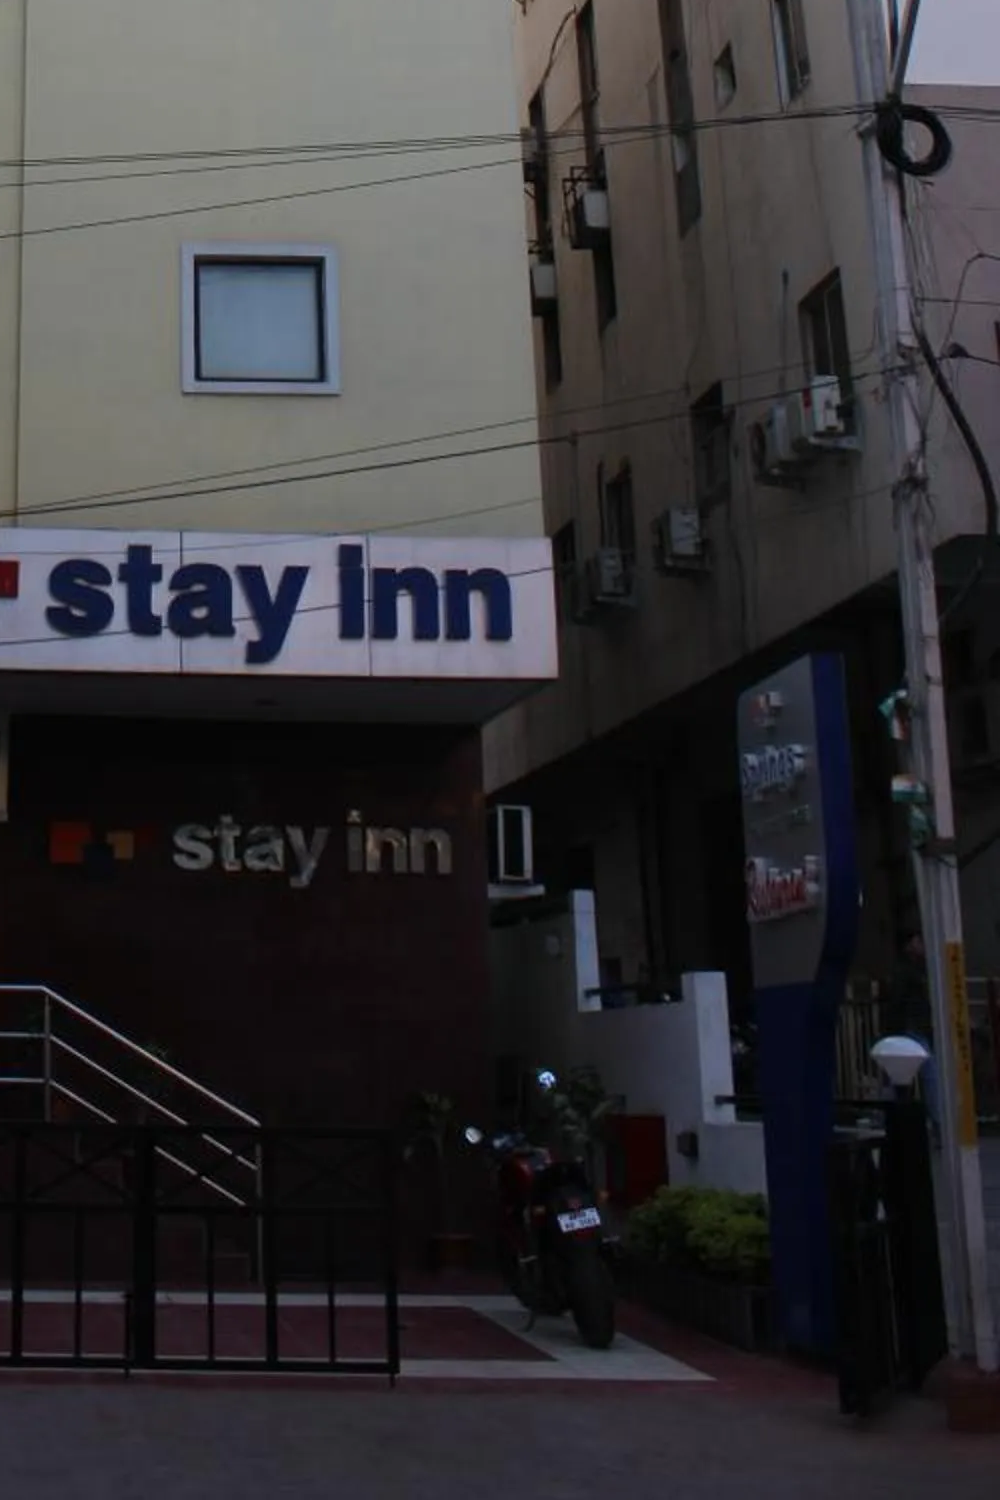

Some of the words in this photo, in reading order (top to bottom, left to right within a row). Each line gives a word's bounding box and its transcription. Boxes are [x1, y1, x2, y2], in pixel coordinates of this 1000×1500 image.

[45, 544, 310, 664] stay
[337, 543, 512, 642] inn
[172, 813, 331, 888] stay
[347, 809, 453, 875] inn
